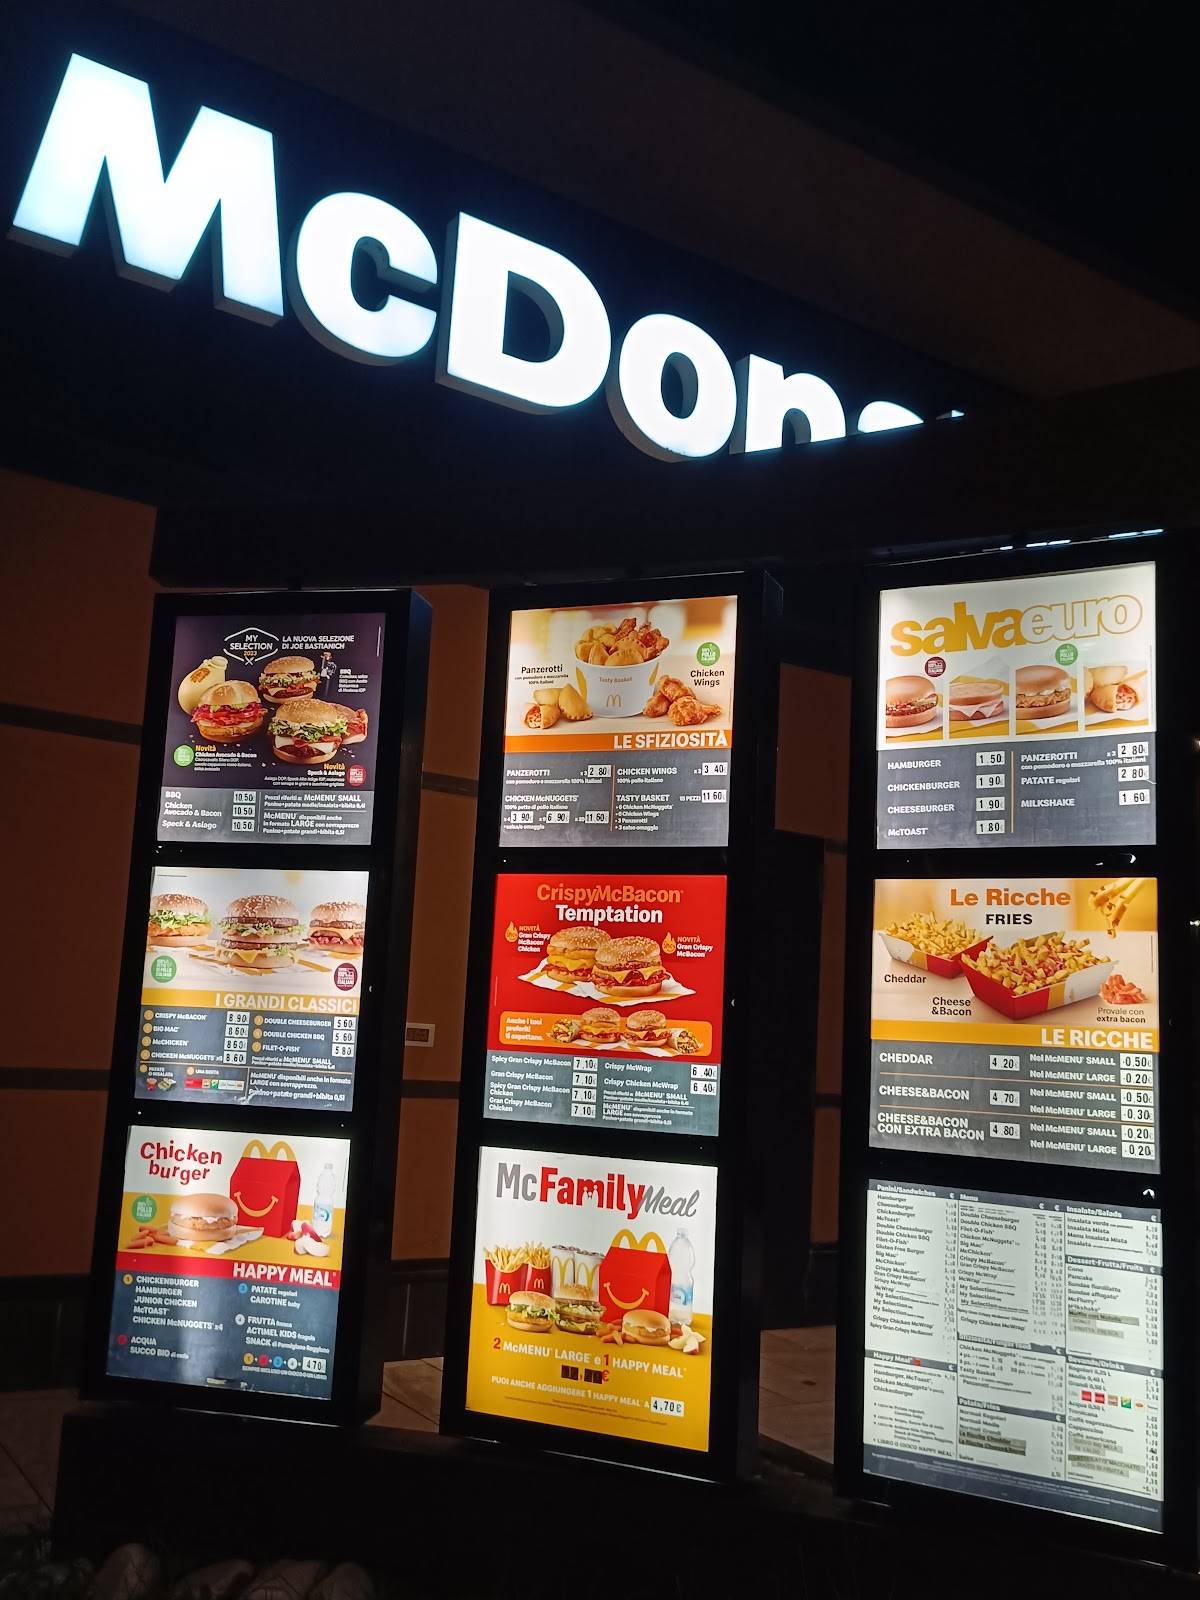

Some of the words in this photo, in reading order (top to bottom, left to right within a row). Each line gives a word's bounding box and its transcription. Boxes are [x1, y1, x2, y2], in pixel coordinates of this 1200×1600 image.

[10, 52, 965, 461] McDon
[230, 642, 273, 650] SELECTION
[521, 664, 563, 674] Panzerotti
[690, 669, 724, 678] Chicken
[694, 678, 719, 688] Wings
[614, 735, 633, 749] LE
[635, 730, 728, 748] SFIZIOSITÀ
[1021, 752, 1077, 761] PANZEROTTI
[888, 760, 941, 769] HAMBURGER
[617, 768, 649, 776] CHICKEN
[888, 781, 960, 791] CHICKENBURGER
[1021, 777, 1054, 785] PATATE
[165, 802, 192, 810] Chicken
[1021, 799, 1075, 808] MILKSHAKE
[888, 804, 954, 814] CHEESEBURGER
[162, 820, 184, 828] Speck
[192, 821, 216, 829] Asiago
[291, 820, 315, 828] LARGE
[951, 889, 978, 906] Le
[986, 888, 1071, 906] Ricche
[556, 905, 662, 925] Temptation
[986, 914, 1032, 925] FRIES
[534, 932, 550, 940] Crispy
[694, 944, 713, 952] Crispy
[884, 974, 926, 984] Cheddar
[216, 994, 220, 1006] I
[224, 993, 285, 1009] GRANDI
[288, 996, 357, 1013] CLASSICI
[932, 997, 971, 1006] Cheese
[287, 1019, 331, 1027] CHEESEBURGER
[287, 1032, 312, 1040] CHICKEN
[312, 1033, 324, 1041] BBQ
[1041, 1029, 1064, 1045] LE
[1070, 1029, 1153, 1049] RICCHE
[492, 1055, 507, 1064] Spicy
[523, 1057, 542, 1066] Crispy
[880, 1053, 933, 1064] CHEDDAR
[1030, 1054, 1043, 1062] Nel
[1086, 1057, 1116, 1066] SMALL
[605, 1062, 624, 1071] Crispy
[604, 1078, 623, 1086] Crispy
[625, 1079, 651, 1087] Chicken
[1087, 1074, 1115, 1082] LARGE
[666, 1092, 687, 1100] SMALL
[879, 1085, 969, 1100] CHEESE&BACON
[504, 1099, 523, 1107] Crispy
[524, 1100, 552, 1108] McBacon
[877, 1113, 968, 1128] CHEESE&BACON
[877, 1124, 902, 1135] CON
[905, 1125, 941, 1137] EXTRA
[944, 1129, 984, 1140] BACON
[140, 1140, 222, 1165] Chicken
[149, 1160, 210, 1185] burger
[233, 1263, 288, 1283] HAPPY
[136, 1276, 199, 1287] CHICKENBURGER
[135, 1286, 182, 1296] HAMBURGER
[252, 1286, 277, 1294] PATATE
[134, 1296, 162, 1305] JUNIOR
[164, 1298, 197, 1307] CHICKEN
[250, 1295, 287, 1306] CAROTINE
[133, 1316, 166, 1325] CHICKEN
[248, 1316, 275, 1326] FRUTTA
[247, 1326, 278, 1337] ACTIMEL
[279, 1330, 297, 1339] KIDS
[131, 1336, 156, 1346] ACQUA
[246, 1337, 271, 1346] SNACK
[130, 1346, 155, 1355] SUCCO
[156, 1348, 170, 1357] BIO
[494, 1338, 501, 1350] 2
[554, 1349, 590, 1364] LARGE
[603, 1354, 610, 1366] 1
[612, 1358, 649, 1372] HAPPY
[510, 1380, 536, 1390] ANCHE
[537, 1384, 586, 1398] AGGIUNGERE
[593, 1392, 618, 1403] HAPPY
[619, 1395, 640, 1407] MEAL
